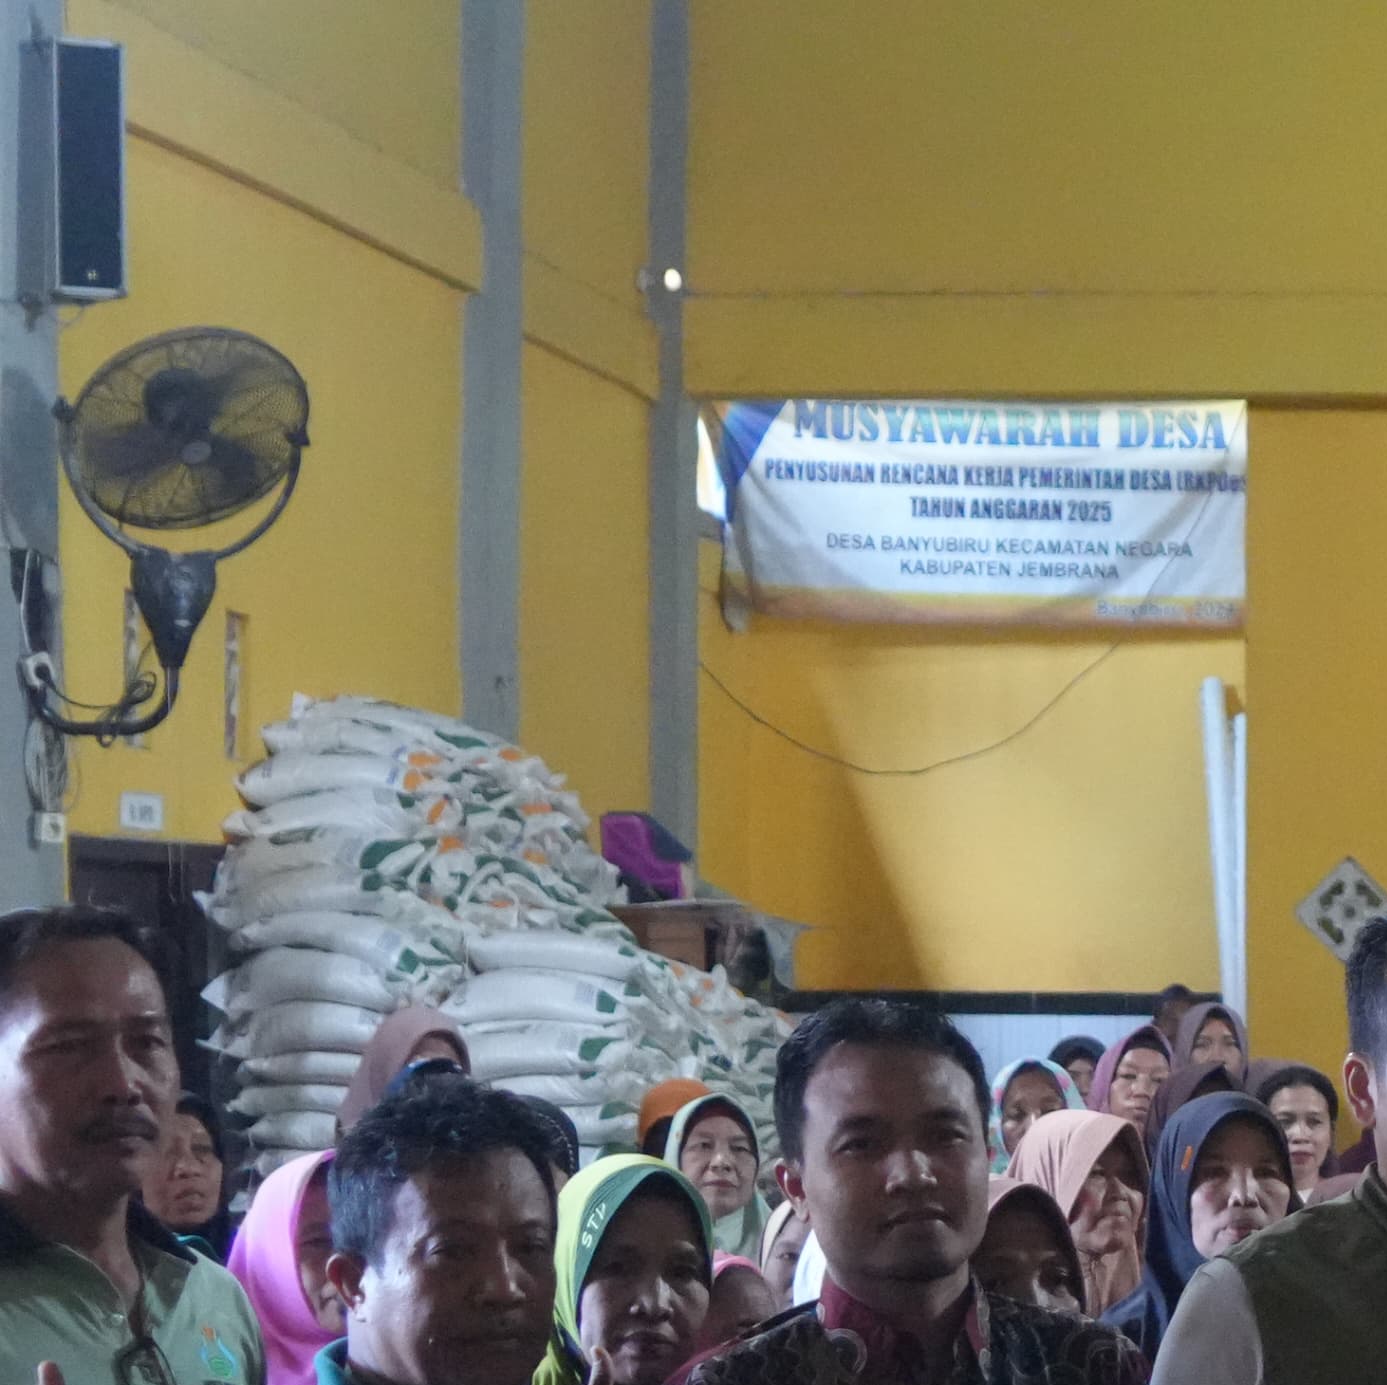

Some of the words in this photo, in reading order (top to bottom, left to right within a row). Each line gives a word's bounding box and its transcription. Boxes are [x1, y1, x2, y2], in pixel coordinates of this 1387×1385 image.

[793, 399, 1101, 448] MUSYAWARAH
[1115, 408, 1227, 449] DESA
[764, 458, 875, 484] PENYUSUNAN
[881, 462, 959, 486] RENCANA
[963, 464, 1013, 488] KERJA
[1018, 466, 1124, 491] PEMERINTAH
[1129, 469, 1172, 491] DESA
[909, 495, 965, 518] TAHUN
[970, 497, 1062, 521] ANGGARAN
[1066, 500, 1113, 522] 2025
[826, 532, 875, 551] DESA
[881, 534, 989, 553] BANYUBIRU
[996, 537, 1109, 557] KECAMATAN
[1115, 540, 1193, 558] NEGARA
[899, 559, 1010, 577] KABUPATEN
[1017, 561, 1120, 579] JEMBRANA
